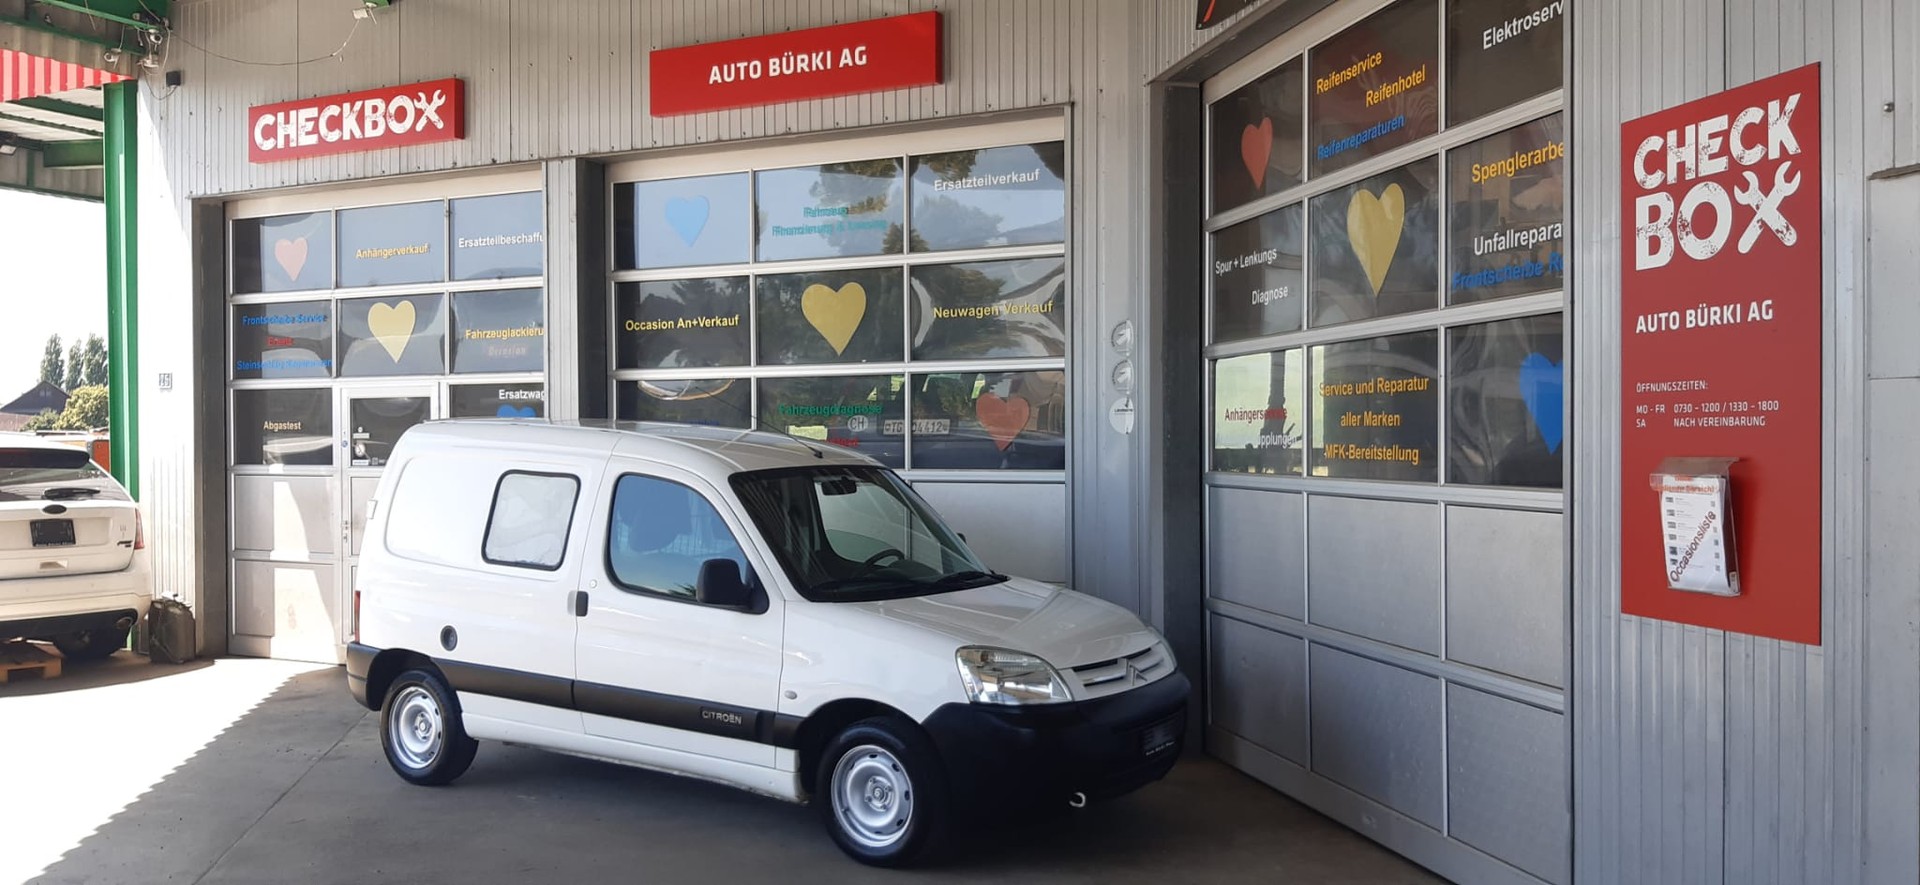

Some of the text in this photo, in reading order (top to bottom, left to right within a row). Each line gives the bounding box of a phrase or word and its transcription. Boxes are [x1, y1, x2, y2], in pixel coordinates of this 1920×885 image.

[1483, 0, 1564, 50] Elektroserv
[708, 45, 868, 84] AUTO BÜRKI AG
[1316, 51, 1382, 95] Reifenservice
[1365, 63, 1427, 108] Reifenhotel
[253, 90, 446, 151] CHECKBOX
[1317, 113, 1406, 160] Reifenreparaturen
[1633, 92, 1802, 190] CHECK
[1471, 140, 1564, 185] Spenglerarbe
[934, 168, 1041, 191] Ersatzteilverkauf
[1635, 160, 1802, 271] BOX
[355, 242, 431, 260] Anhängerverkauf
[1474, 222, 1563, 257] Unfallrepara
[1215, 248, 1277, 277] Spur + Lenkungs
[933, 300, 1054, 318] Neuwagen Verkauf
[1251, 286, 1289, 306] Diagnose
[625, 314, 740, 331] Occasion An+Verkauf
[1635, 299, 1773, 334] AUTO BÜRKI AG
[1319, 376, 1430, 397] Service und Reparatur
[1636, 380, 1709, 393] ÖFFNUNGSZEITEN:
[1340, 410, 1401, 427] aller Marken
[1636, 405, 1648, 414] MO
[1655, 404, 1665, 413] FR
[1674, 403, 1692, 413] 0730
[1701, 403, 1720, 413] 1200
[1729, 402, 1748, 412] 1330
[1758, 400, 1779, 411] 1800
[263, 421, 301, 431] Abgastest
[850, 418, 866, 429] CH
[1636, 415, 1766, 428] SA NACH VEREINBARUNG
[1670, 511, 1716, 583] Occasionsliste
[702, 710, 742, 725] CITROËN
